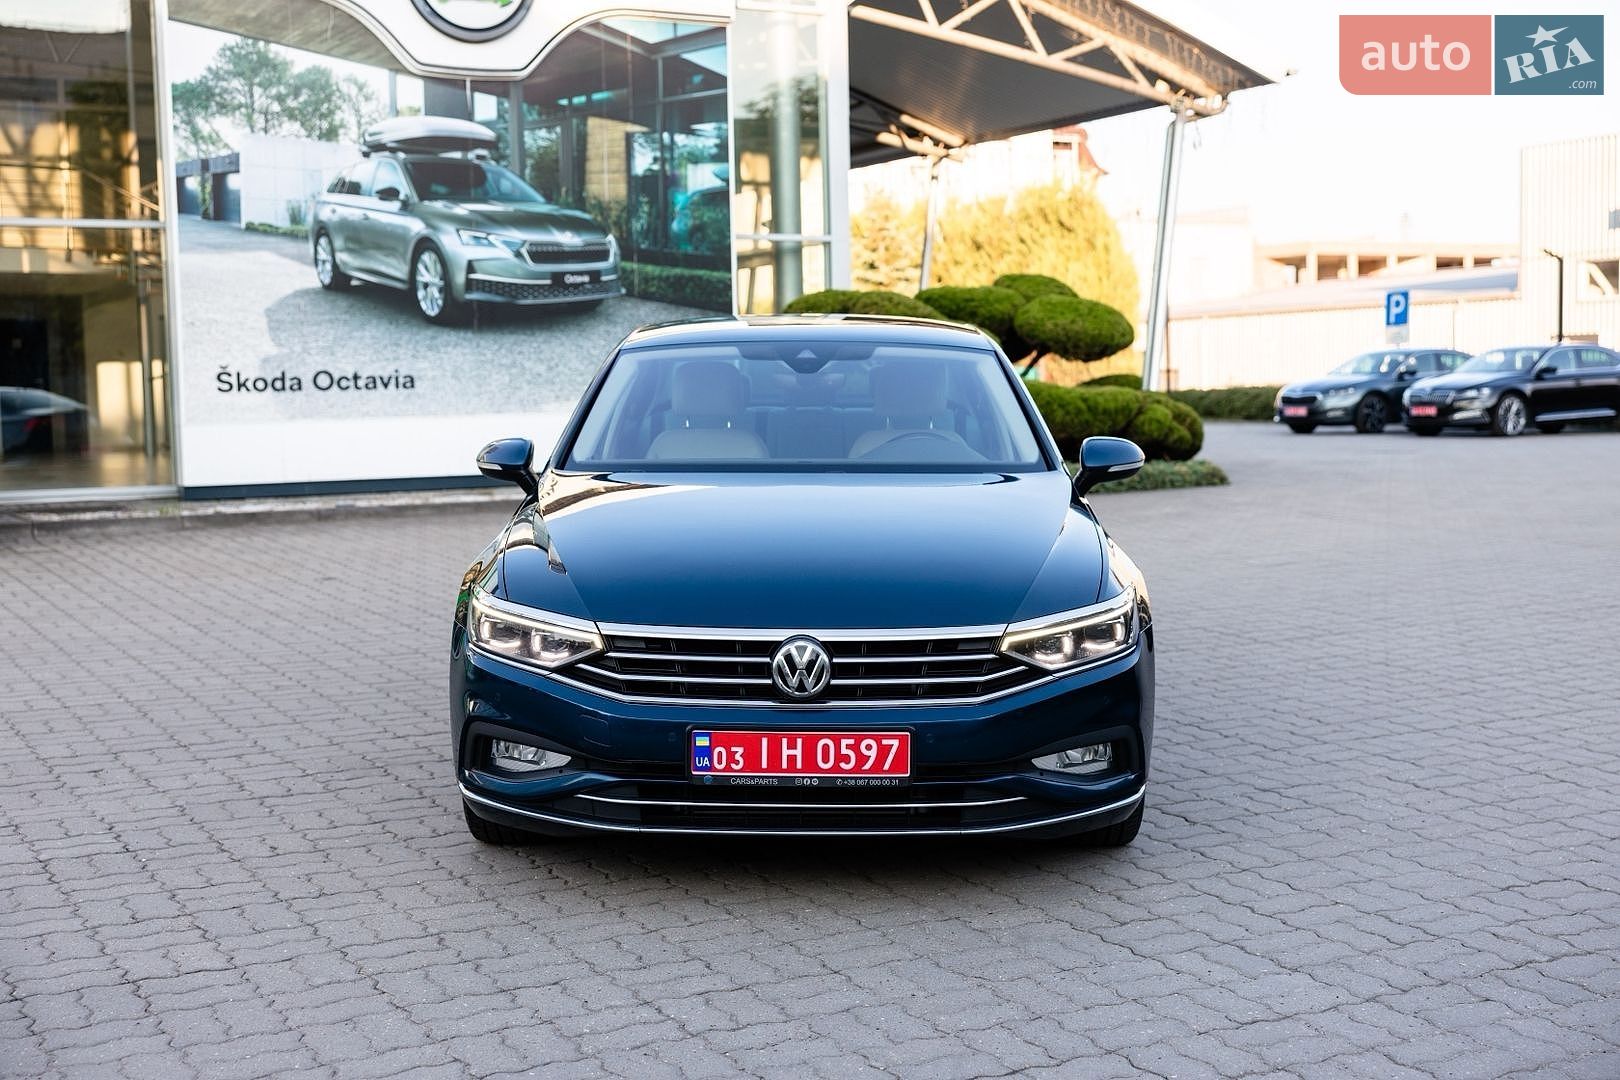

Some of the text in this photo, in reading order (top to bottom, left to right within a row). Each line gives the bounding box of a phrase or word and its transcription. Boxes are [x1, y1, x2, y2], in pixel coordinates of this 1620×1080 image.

[1389, 294, 1406, 324] P
[216, 365, 415, 393] Škoda Octavia
[695, 756, 710, 768] UA
[713, 737, 900, 771] 03 IH 0597
[730, 777, 778, 785] CARS&PARTS
